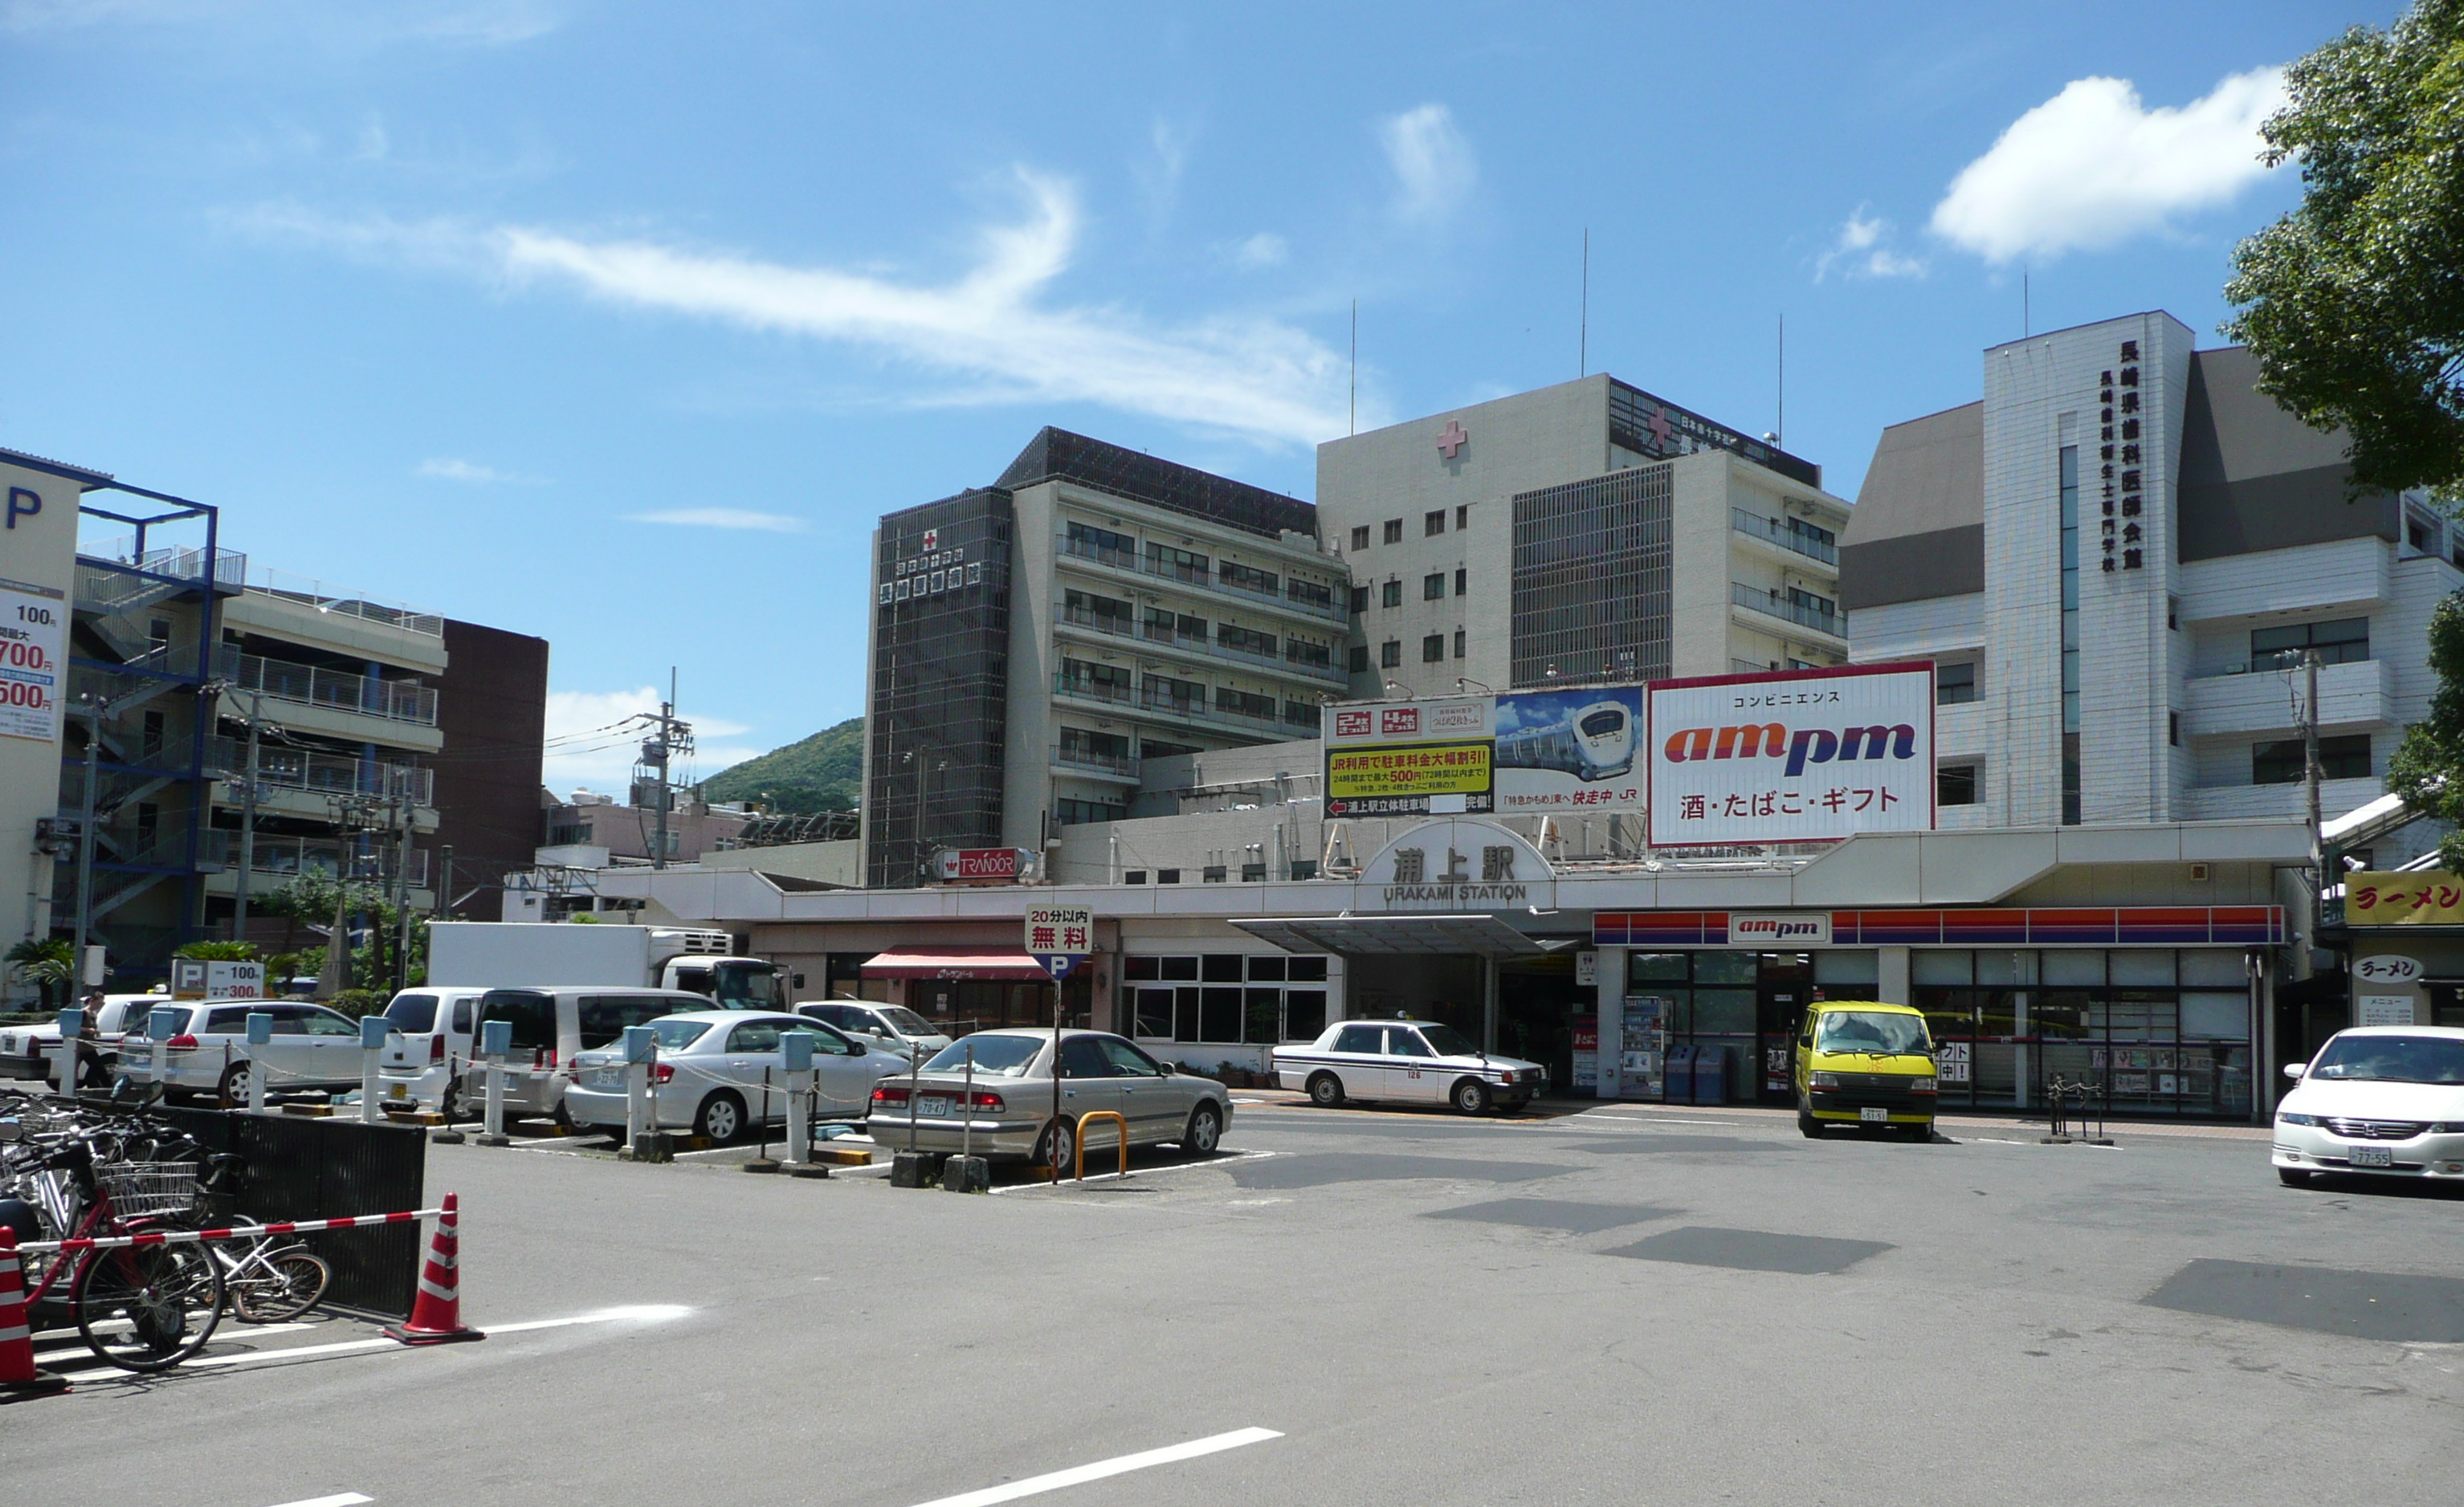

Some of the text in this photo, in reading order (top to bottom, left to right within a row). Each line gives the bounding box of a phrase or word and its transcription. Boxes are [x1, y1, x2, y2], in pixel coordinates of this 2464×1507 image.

[7, 487, 42, 529] P
[1734, 691, 1840, 708] コンビニエンス
[1664, 723, 1916, 777] ampm
[1572, 789, 1613, 806] 快走中
[1619, 788, 1637, 799] JR
[1680, 786, 1899, 820] 酒・たばこ・ギフト
[1393, 845, 1515, 882] 浦上駅
[1384, 885, 1526, 901] URAKAMI STATION
[2356, 886, 2461, 910] ラーメン
[1031, 910, 1088, 923] 20分以内
[1031, 926, 1087, 949] 無料
[1739, 920, 1817, 938] ampm
[1050, 955, 1068, 975] P
[2361, 961, 2414, 976] ラーメン
[1408, 1070, 1421, 1079] 126
[923, 1103, 944, 1114] 70-47
[1866, 1112, 1885, 1120] 51-51
[2358, 1153, 2388, 1164] 77-55
